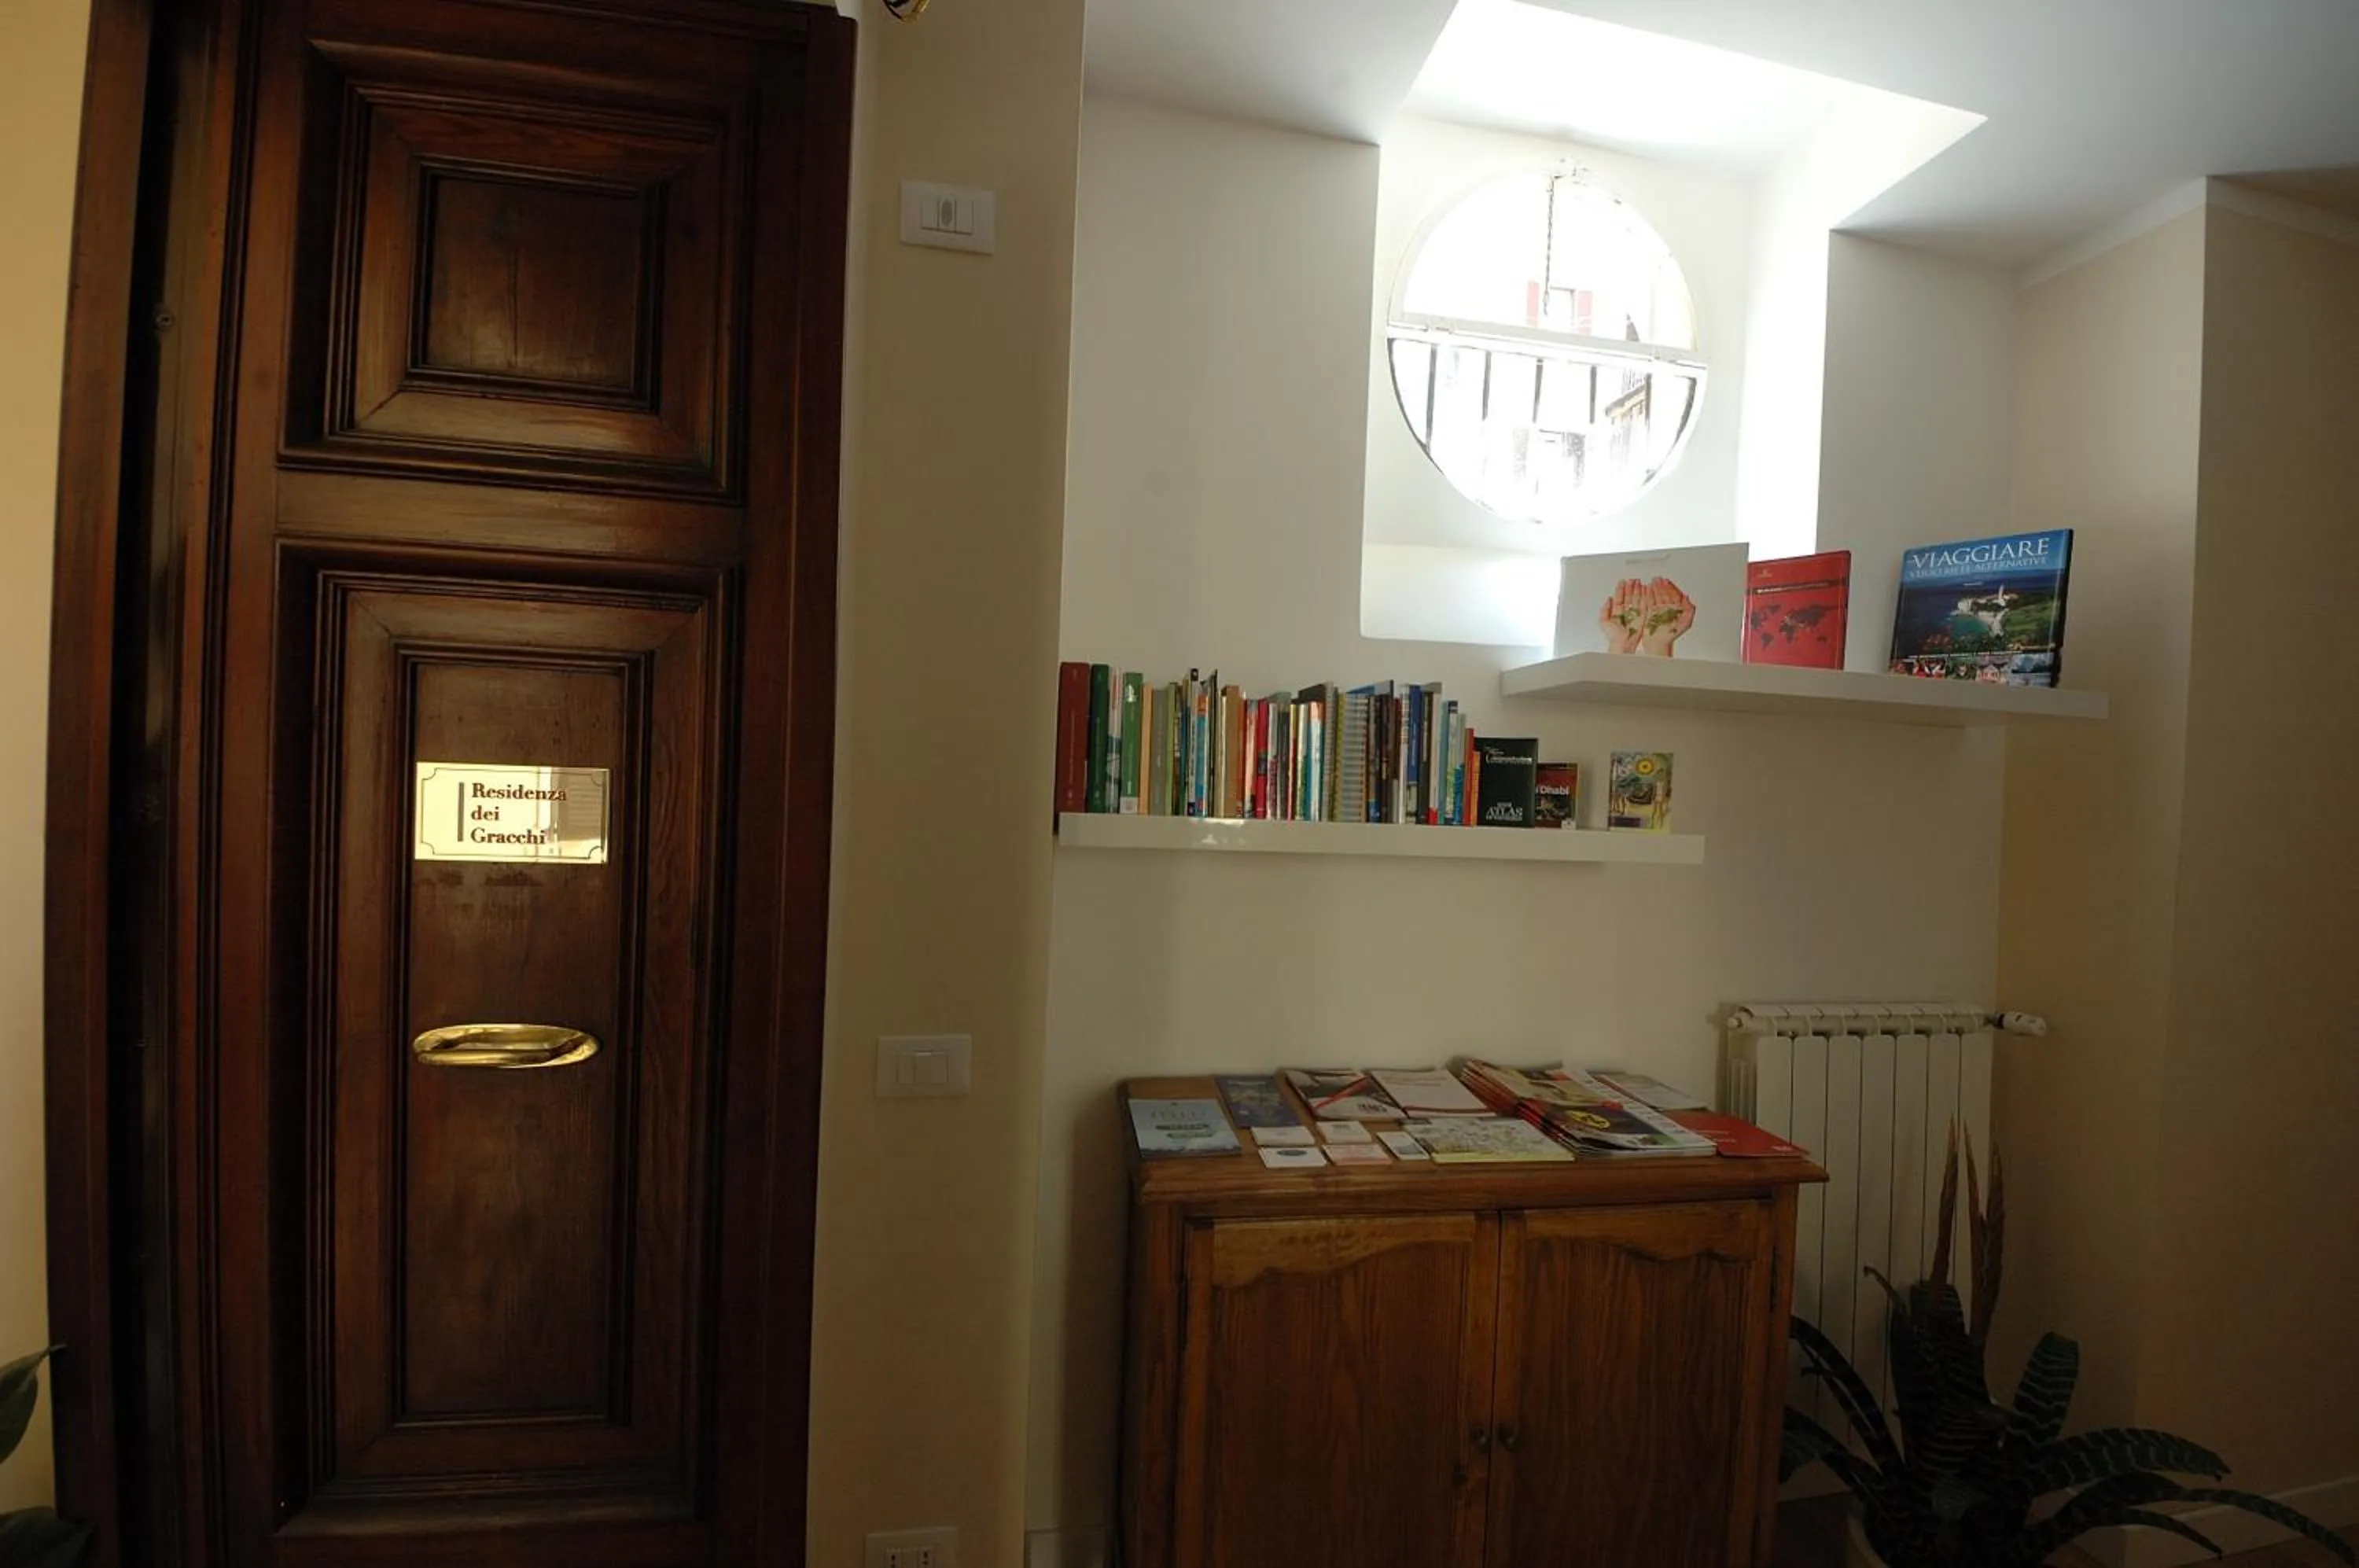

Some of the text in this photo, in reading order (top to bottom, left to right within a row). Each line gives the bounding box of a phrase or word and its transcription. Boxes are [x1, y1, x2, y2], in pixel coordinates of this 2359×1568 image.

[1912, 538, 2050, 569] VIAGGIARE
[471, 782, 567, 801] Residenza
[1540, 785, 1570, 796] Dhabi
[470, 806, 500, 821] dei
[470, 827, 547, 845] Gracchi
